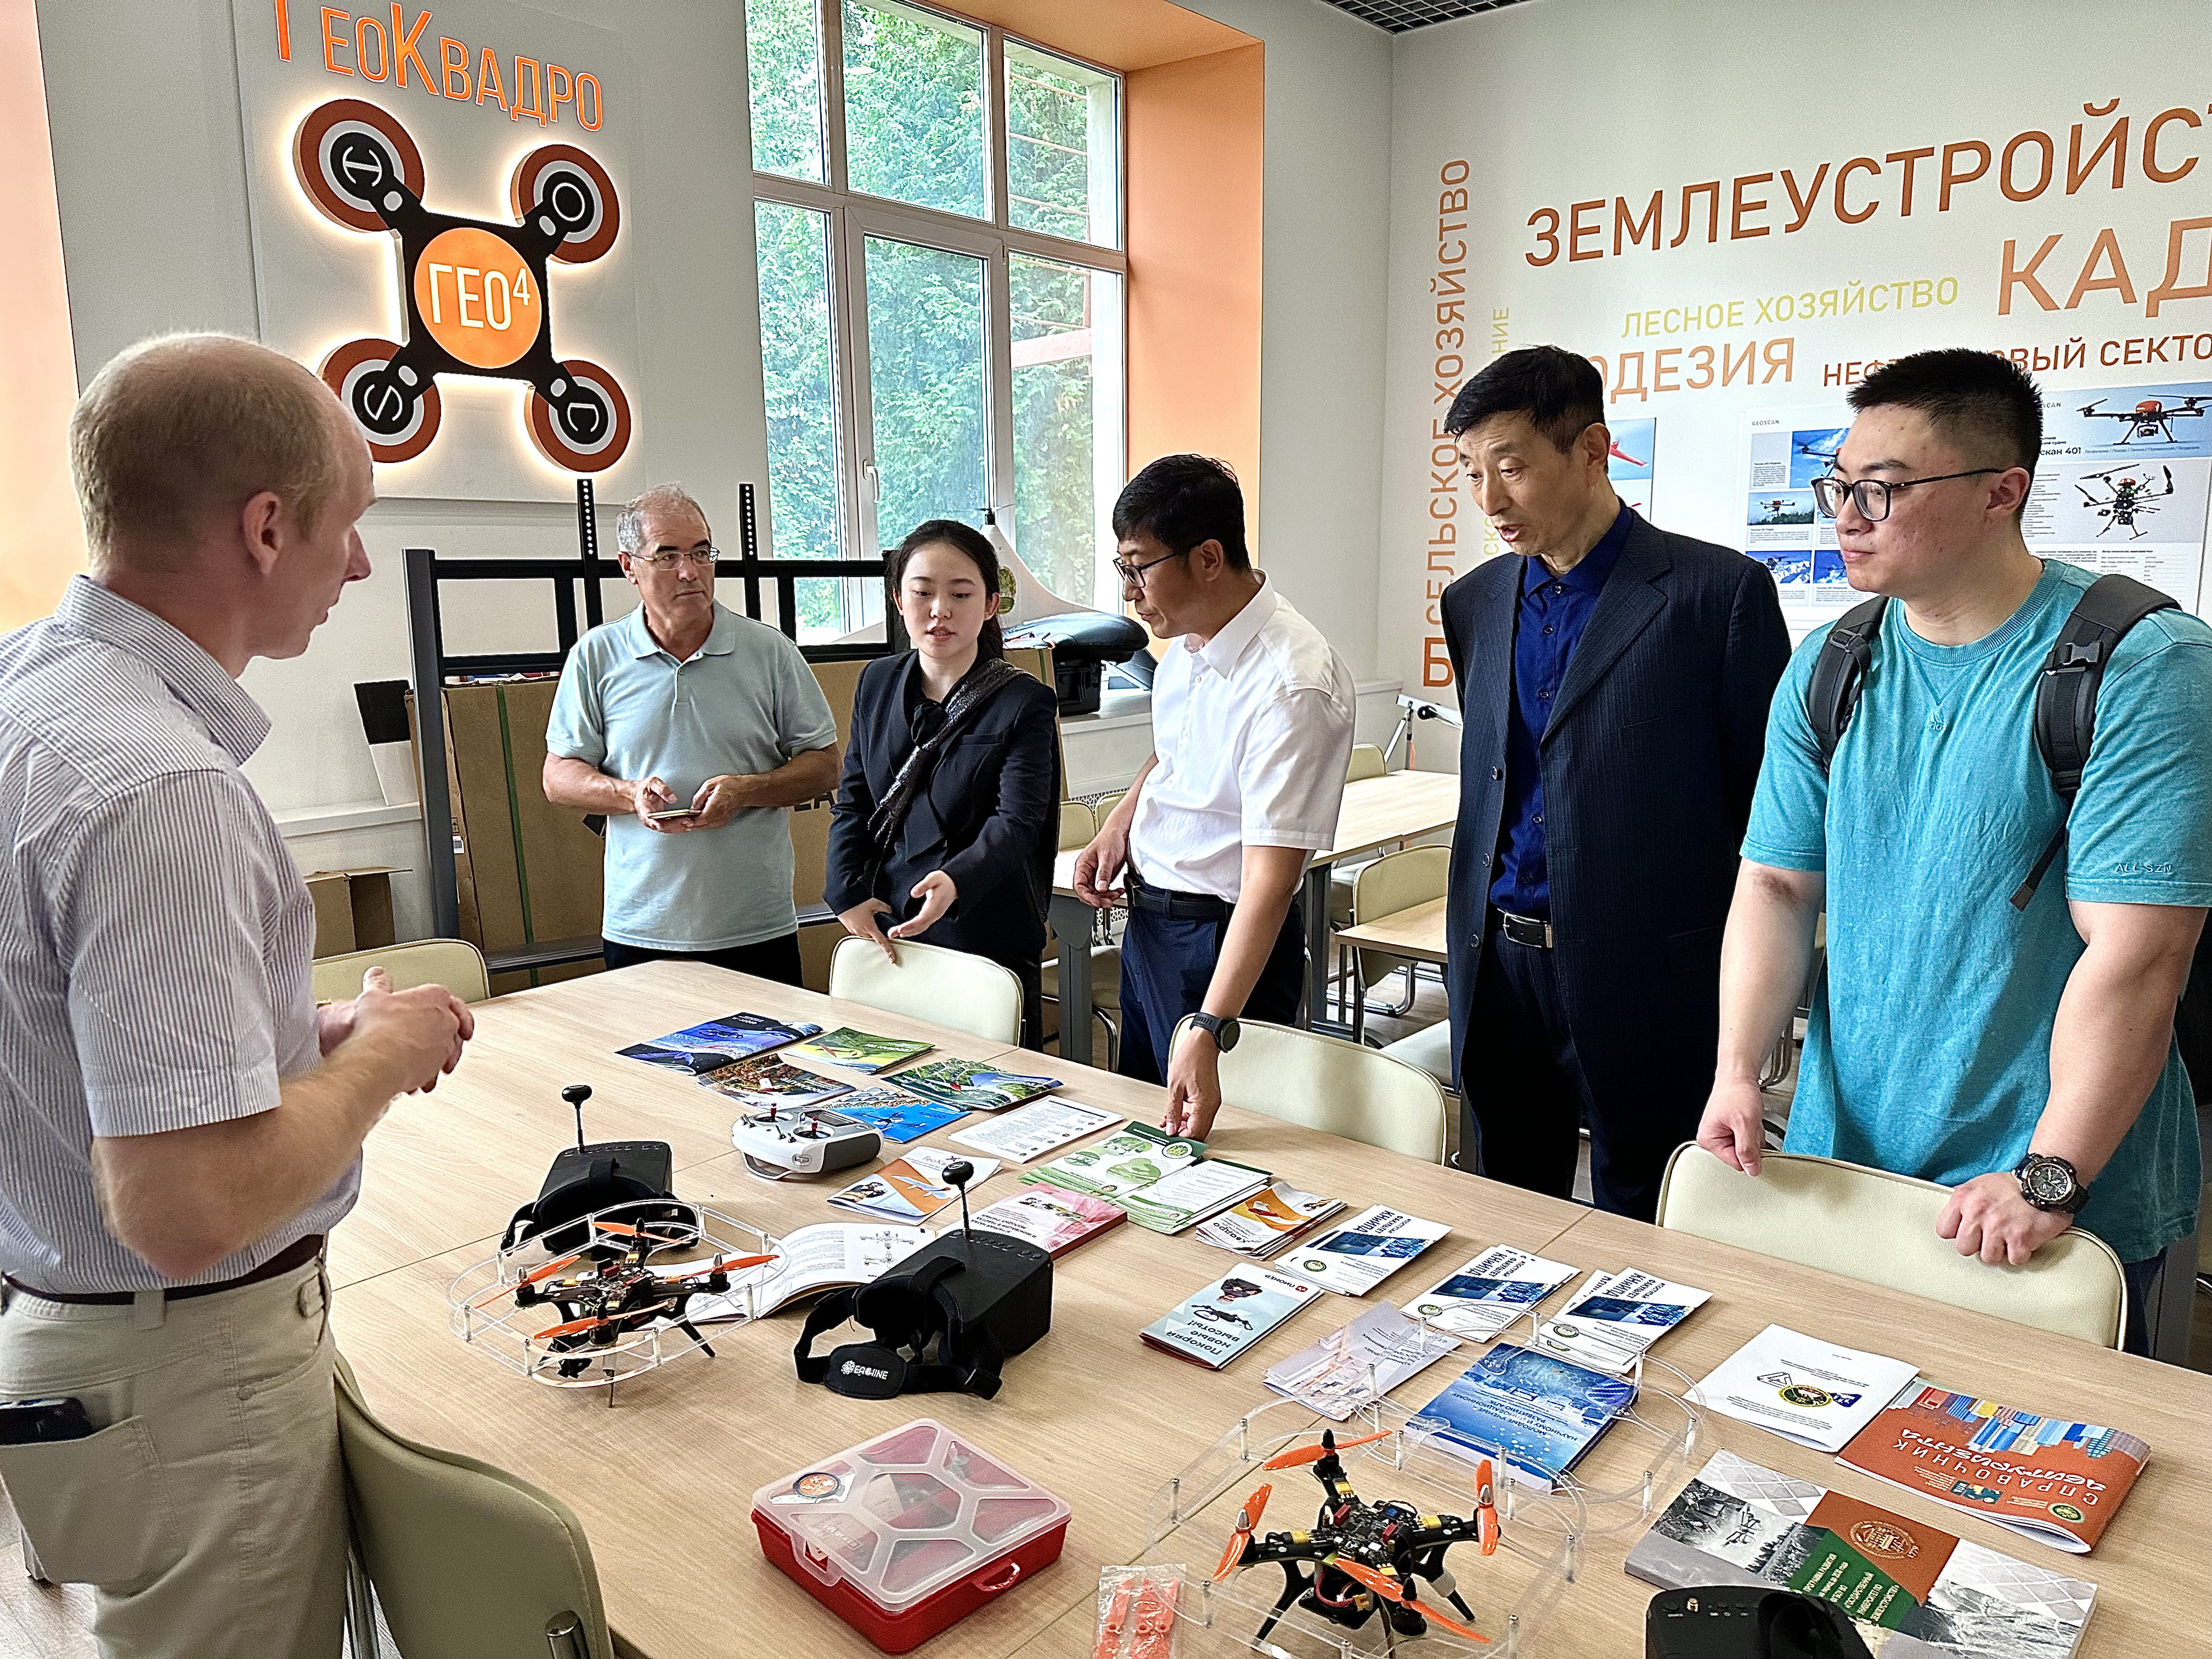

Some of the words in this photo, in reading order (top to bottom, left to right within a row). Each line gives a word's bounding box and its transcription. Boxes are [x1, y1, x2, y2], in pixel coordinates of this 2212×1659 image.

[1525, 98, 2212, 268] ЗЕМЛЕУСТРОЙС
[1621, 301, 1745, 338] ЛЕСНОЕ
[1754, 277, 1959, 325] ХОЗЯЙСТВО
[1585, 337, 1795, 404] ОДЕЗИЯ
[1374, 1216, 1403, 1234] ФАКУЛЬТЕТ
[1488, 1258, 1516, 1277] ФАКУЛЬТЕТ
[1265, 1274, 1296, 1288] ПИОНЕР
[1626, 1279, 1656, 1299] ФАКУЛЬТЕТ
[1166, 1331, 1222, 1356] Покоряй
[1190, 1330, 1231, 1348] новые
[1477, 1407, 1506, 1421] УЧЕНЫЕ
[1505, 1405, 1547, 1423] РАЗВИТИЮ
[1507, 1418, 1547, 1436] МОЛОДЫЕ
[1534, 1423, 1578, 1441] НАУЧНОМУ
[1893, 1438, 2098, 1506] СПРАВОЧНИК
